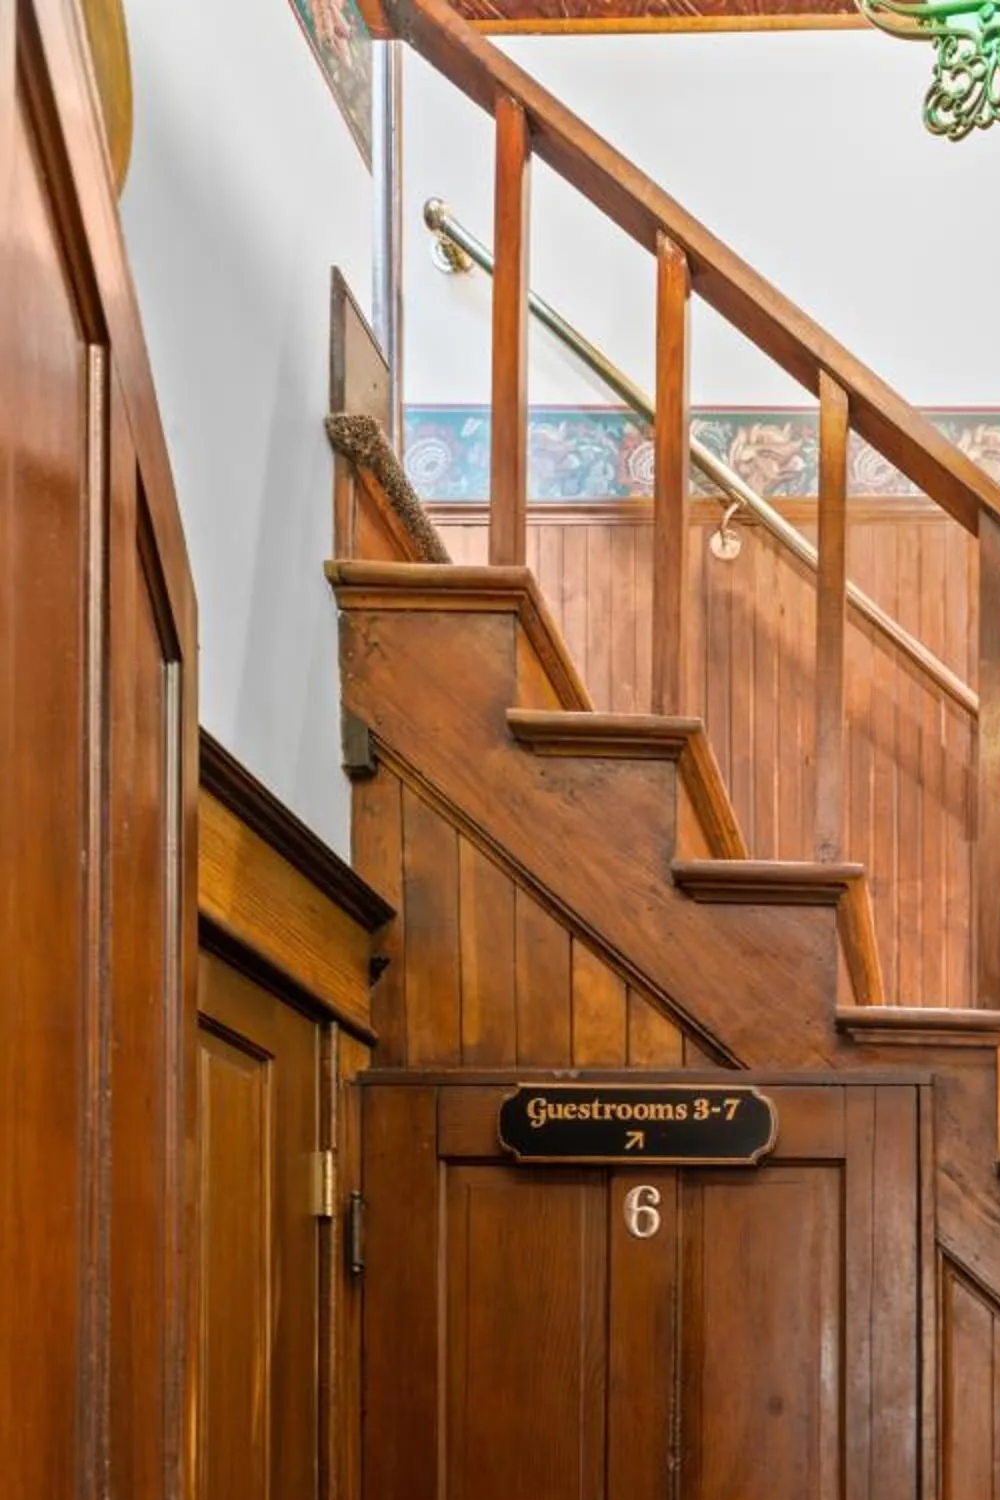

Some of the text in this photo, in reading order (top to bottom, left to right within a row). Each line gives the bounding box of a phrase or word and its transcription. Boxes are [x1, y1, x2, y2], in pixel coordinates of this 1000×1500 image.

[526, 1097, 741, 1128] Guestrooms 3-7
[623, 1185, 661, 1238] 6
